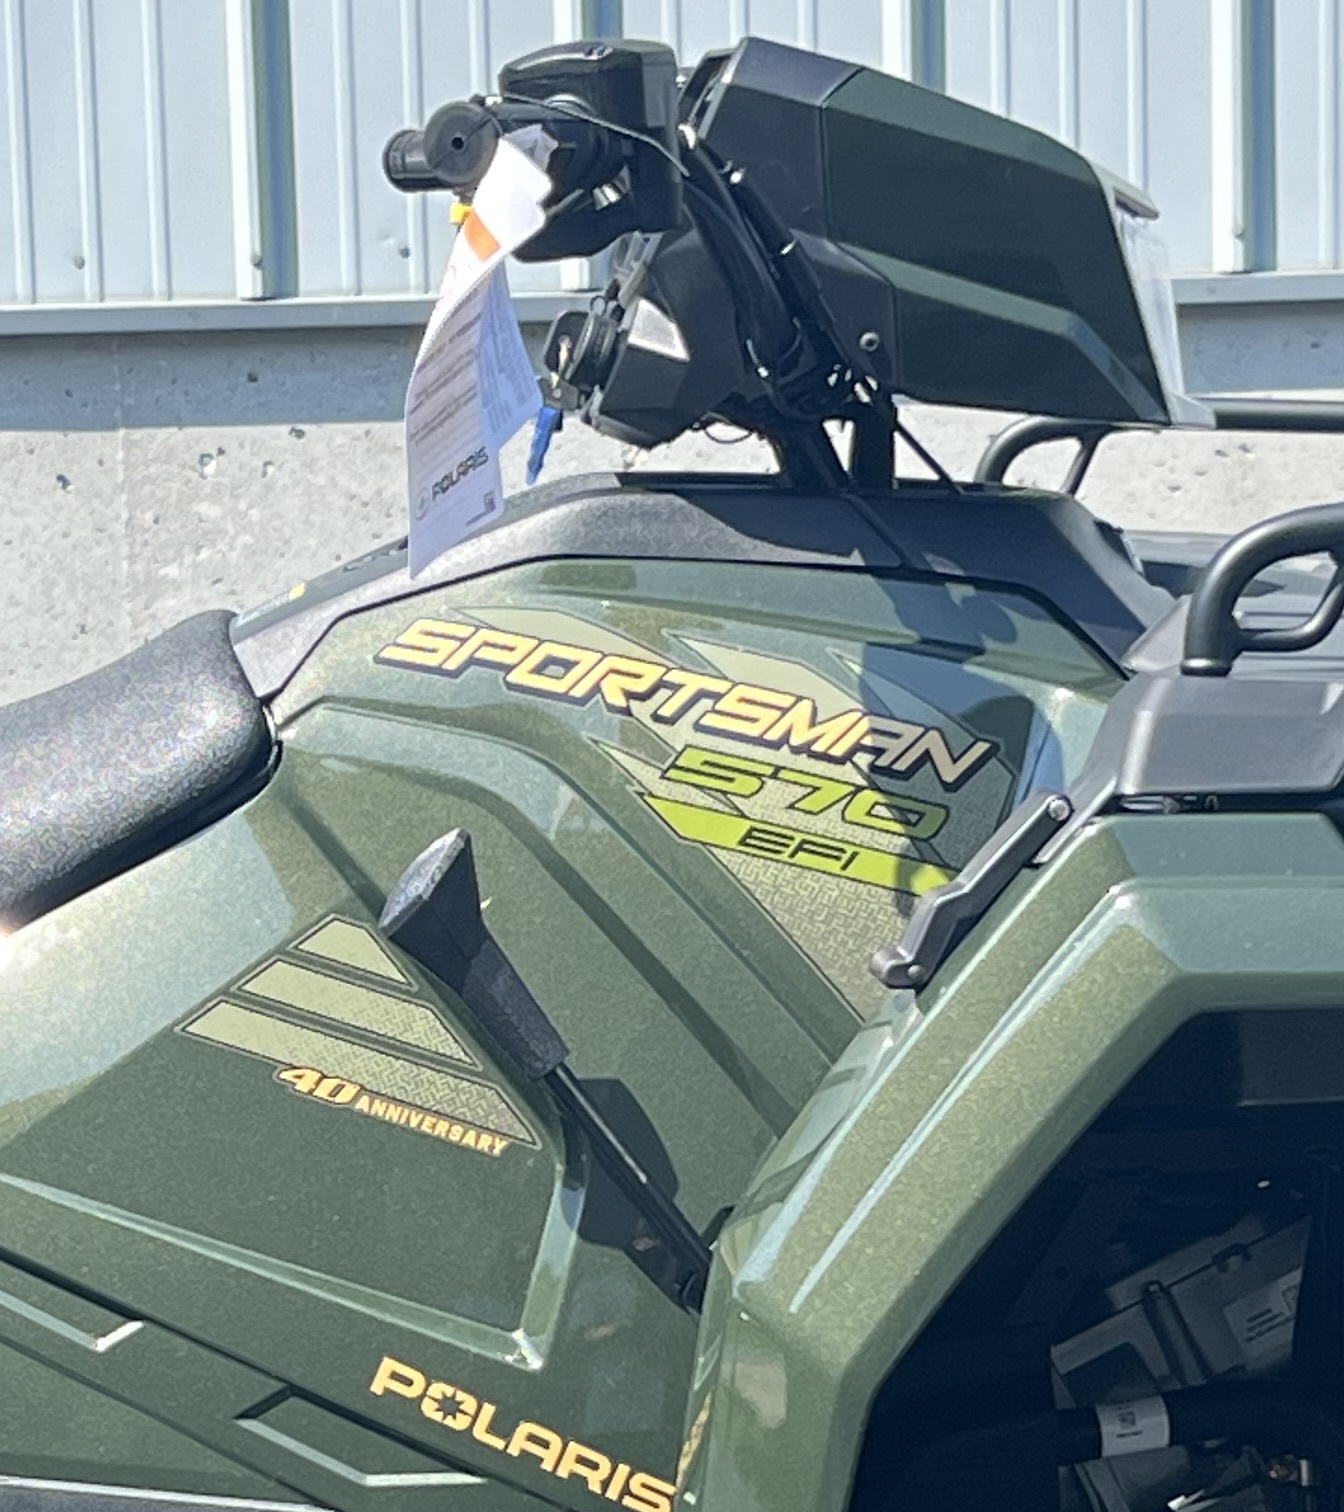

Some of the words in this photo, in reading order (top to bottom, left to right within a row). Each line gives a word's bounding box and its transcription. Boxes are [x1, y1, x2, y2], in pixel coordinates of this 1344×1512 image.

[432, 446, 488, 501] POLARIS
[374, 618, 998, 791] SPORTSMAN
[661, 744, 950, 842] 570
[736, 826, 862, 873] EFI
[278, 1066, 362, 1106] 40
[355, 1096, 511, 1156] ANNIVERSARY
